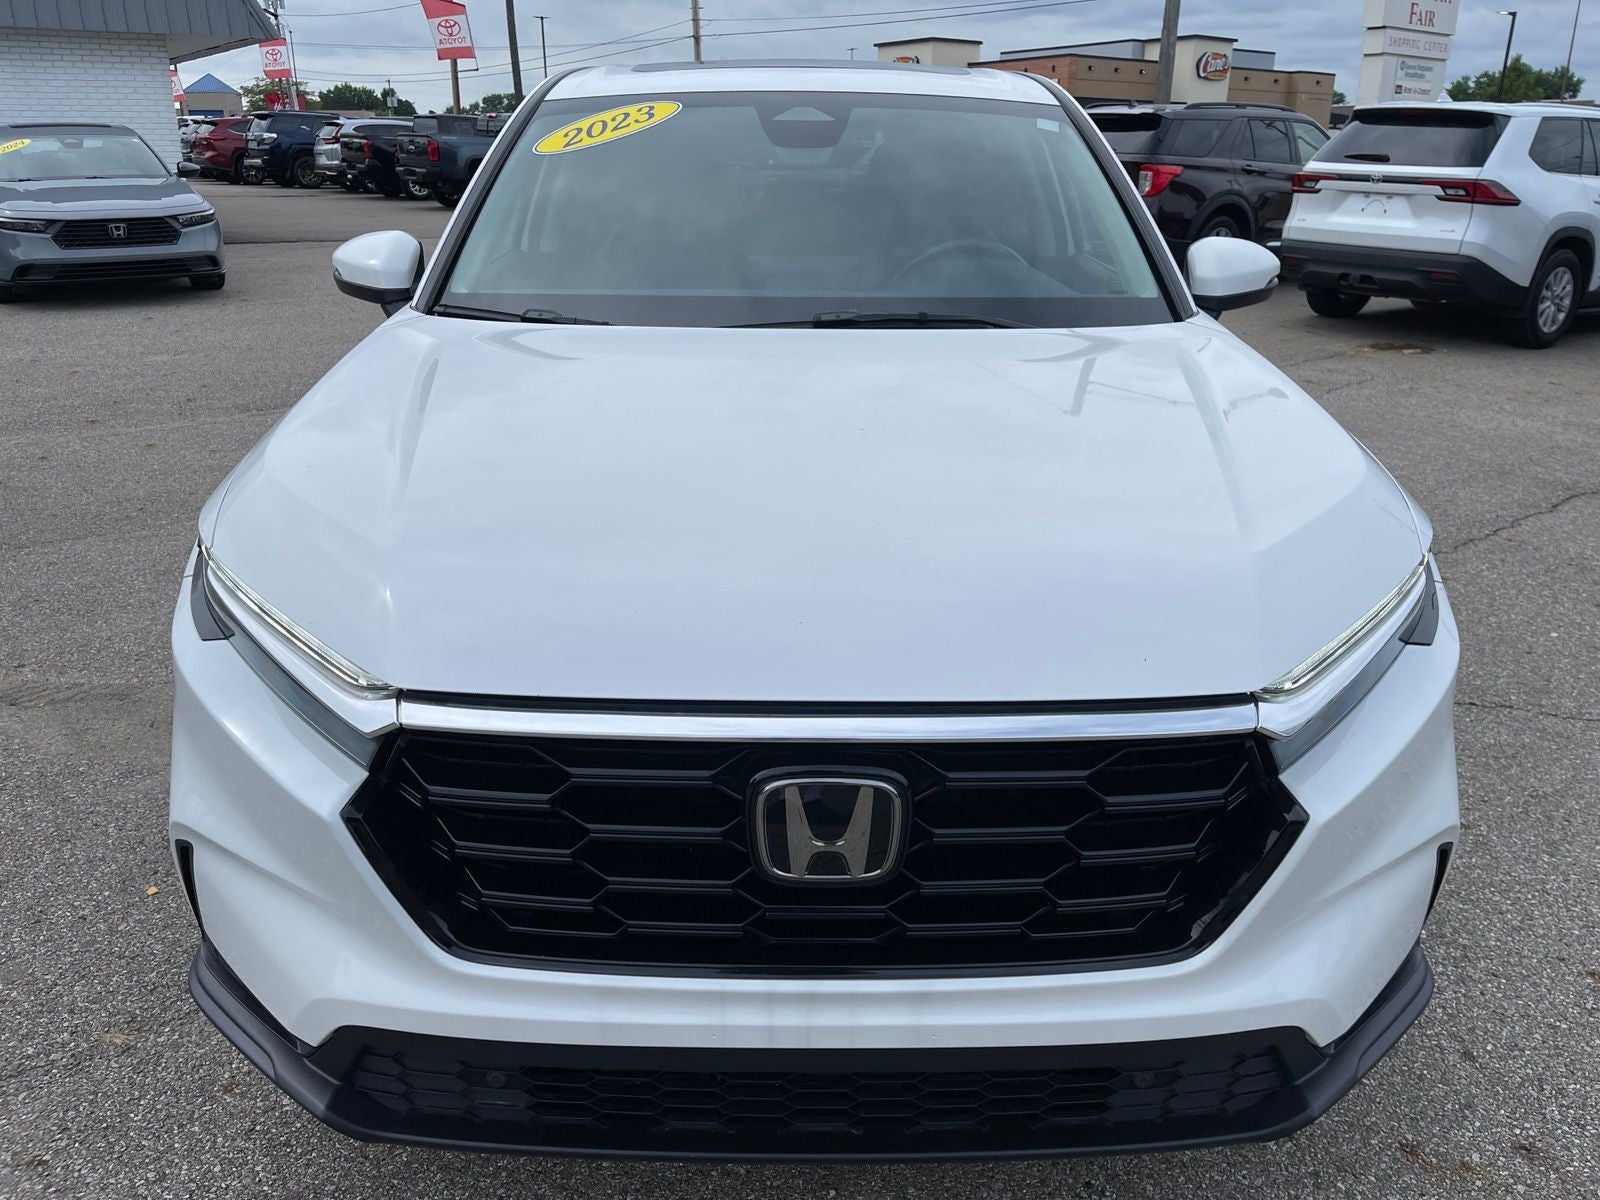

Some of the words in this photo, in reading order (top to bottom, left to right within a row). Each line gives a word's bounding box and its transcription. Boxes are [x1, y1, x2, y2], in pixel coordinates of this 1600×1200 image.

[1388, 36, 1421, 50] SHOPPING
[1424, 41, 1448, 53] CENTER
[562, 105, 656, 149] 2023
